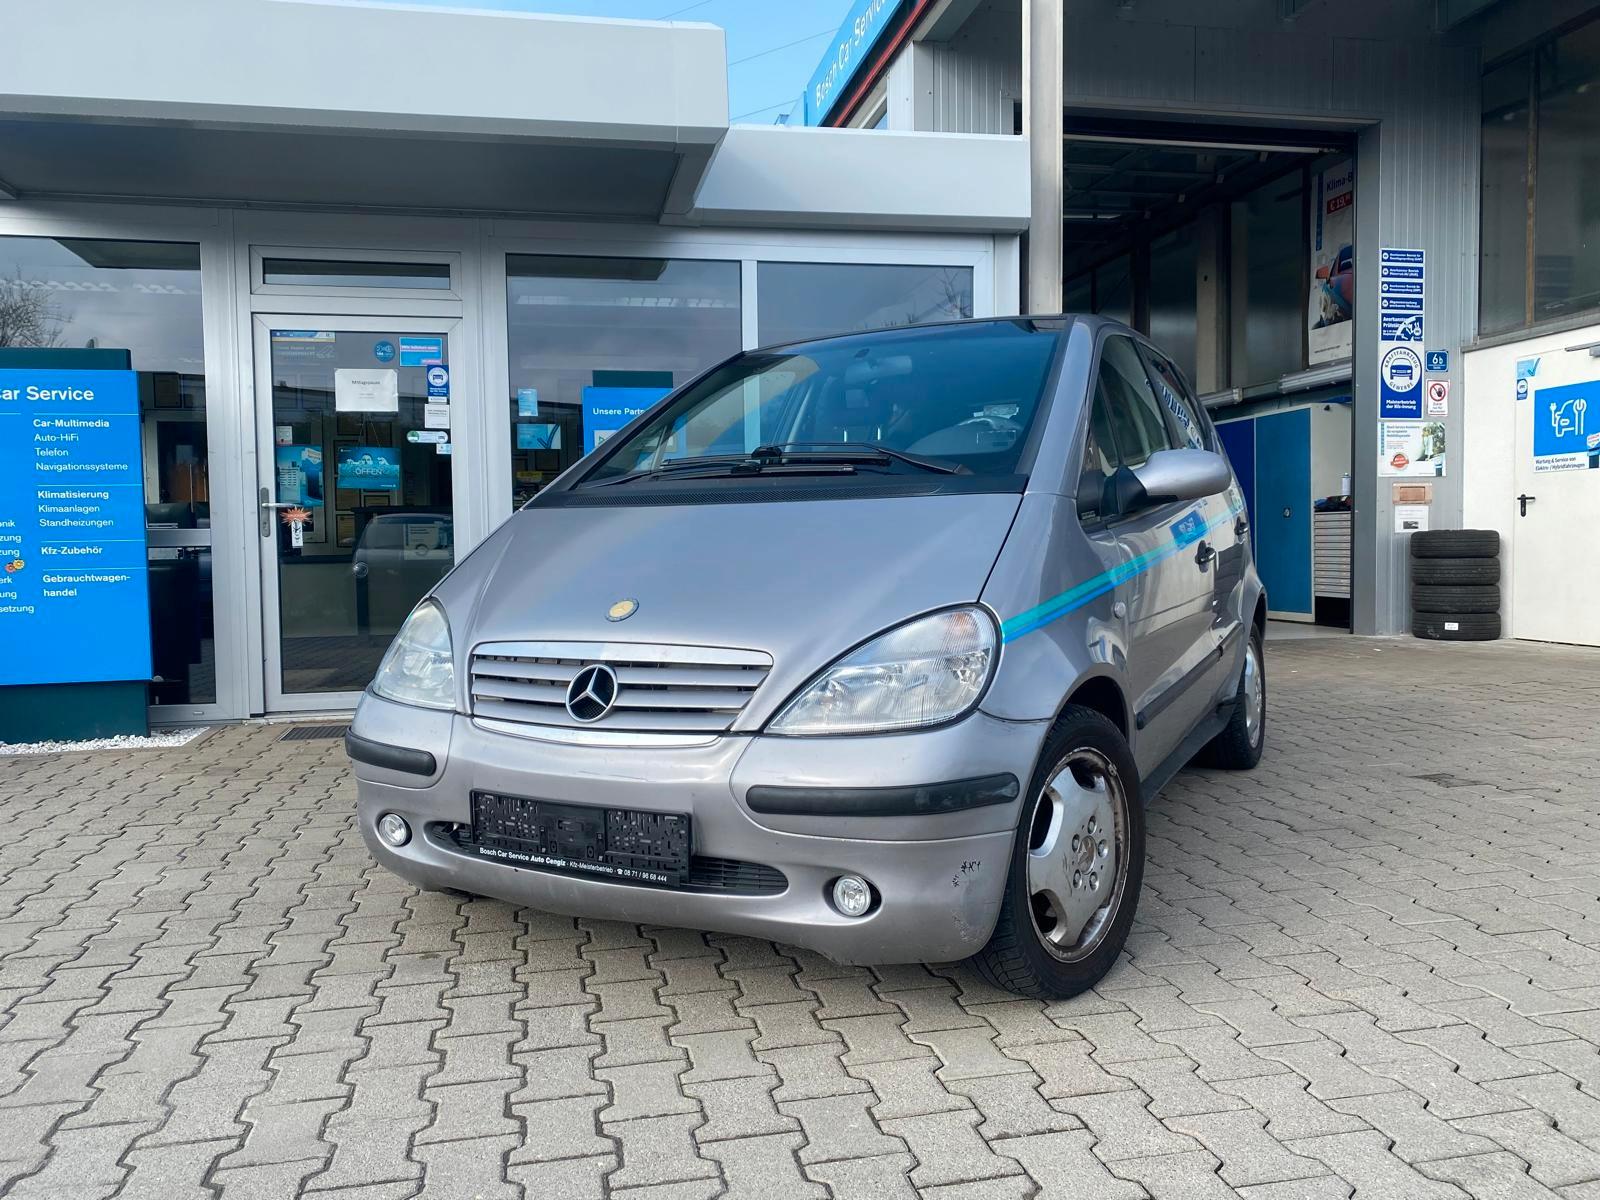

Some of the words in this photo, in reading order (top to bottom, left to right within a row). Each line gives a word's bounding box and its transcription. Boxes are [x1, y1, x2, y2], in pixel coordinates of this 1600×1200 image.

[816, 61, 838, 108] Bosch
[838, 37, 853, 71] Car
[1384, 350, 1420, 369] KRAFTFAHRZEUG
[1389, 381, 1413, 391] GEWERBE
[0, 387, 20, 400] ar
[26, 385, 95, 401] Service
[592, 407, 622, 416] Unsere
[33, 418, 110, 428] Car-Multimedia
[34, 433, 79, 442] Auto-HiFi
[34, 447, 69, 456] Telefon
[35, 462, 129, 473] Navigationssysteme
[38, 490, 109, 500] Klimatisierung
[38, 504, 100, 515] Klimaanlagen
[39, 518, 114, 528] Standheizungen
[41, 546, 103, 555] Kfz-Zubehör
[42, 574, 131, 584] Gebrauchtwagen-
[43, 588, 78, 597] handel
[479, 847, 497, 857] Bosch
[497, 849, 508, 858] Car
[508, 852, 530, 861] Service
[530, 855, 545, 863] Auto
[545, 857, 566, 867] Cengiz
[569, 861, 614, 873] Kfz-Meisterbetrieb
[631, 870, 639, 878] 71
[657, 874, 667, 882] 444
